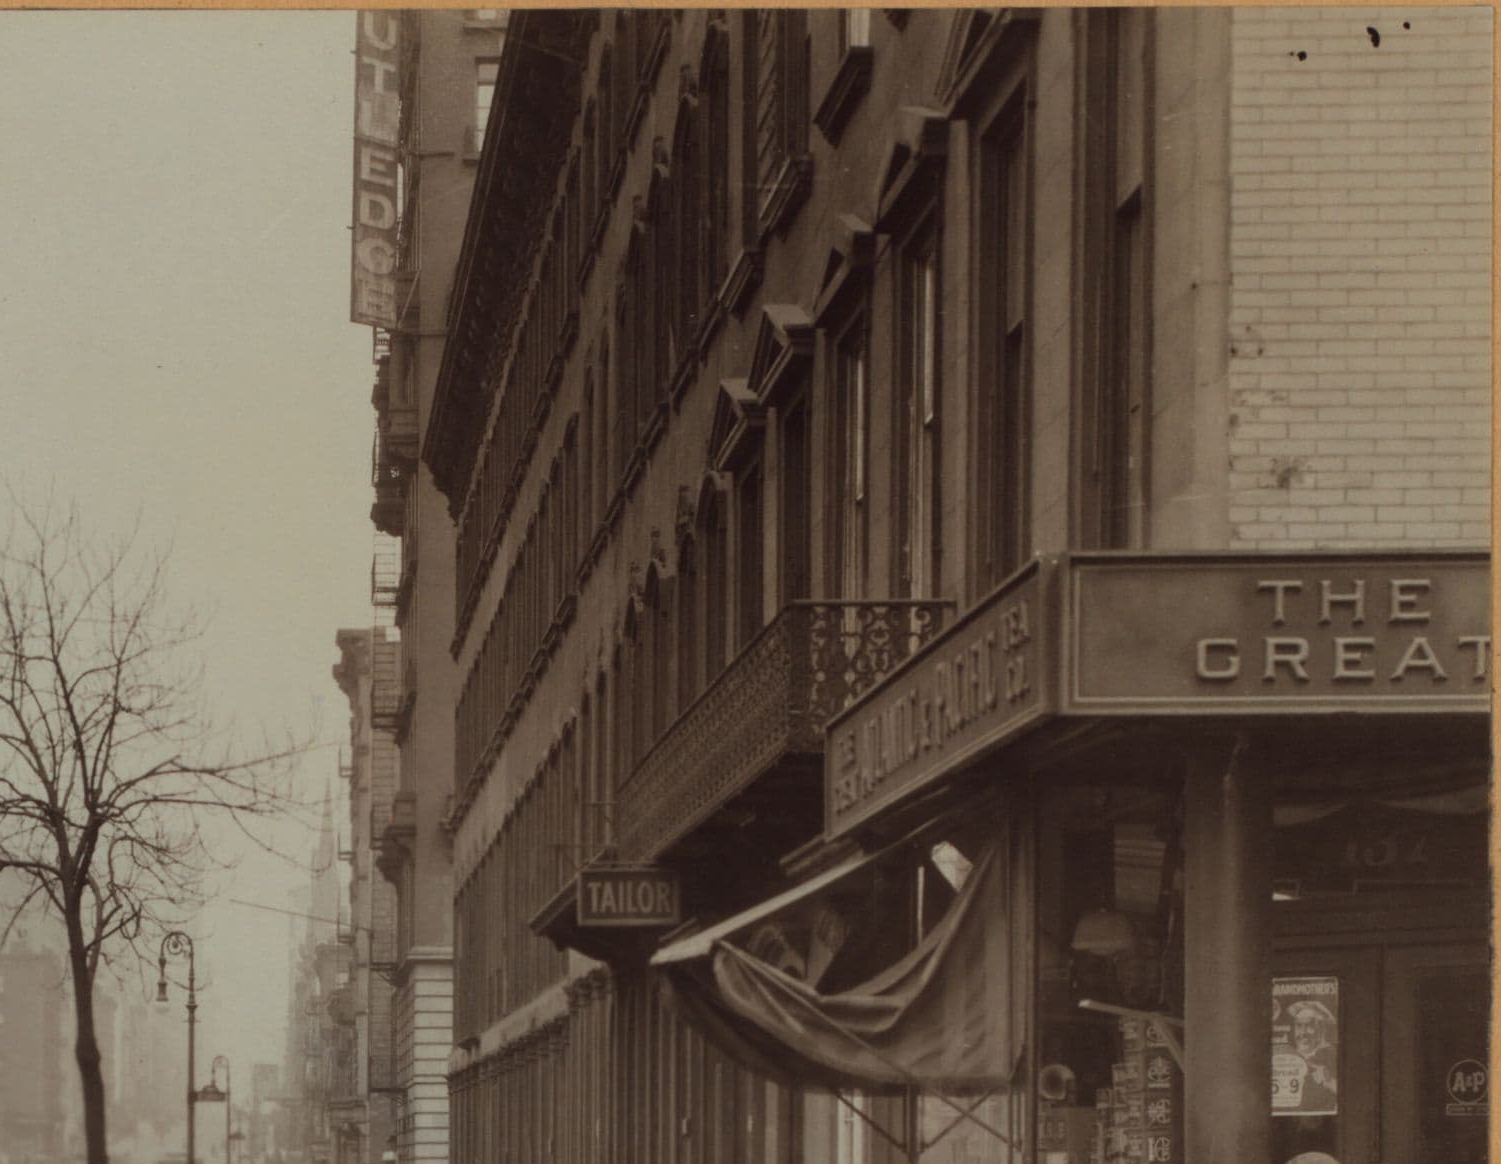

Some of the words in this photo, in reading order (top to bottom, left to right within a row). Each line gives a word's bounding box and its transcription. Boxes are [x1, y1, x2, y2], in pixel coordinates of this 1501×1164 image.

[1257, 578, 1432, 625] THE
[1196, 634, 1491, 683] GREAT
[587, 881, 671, 913] TAILOR
[1452, 1071, 1485, 1092] A&P
